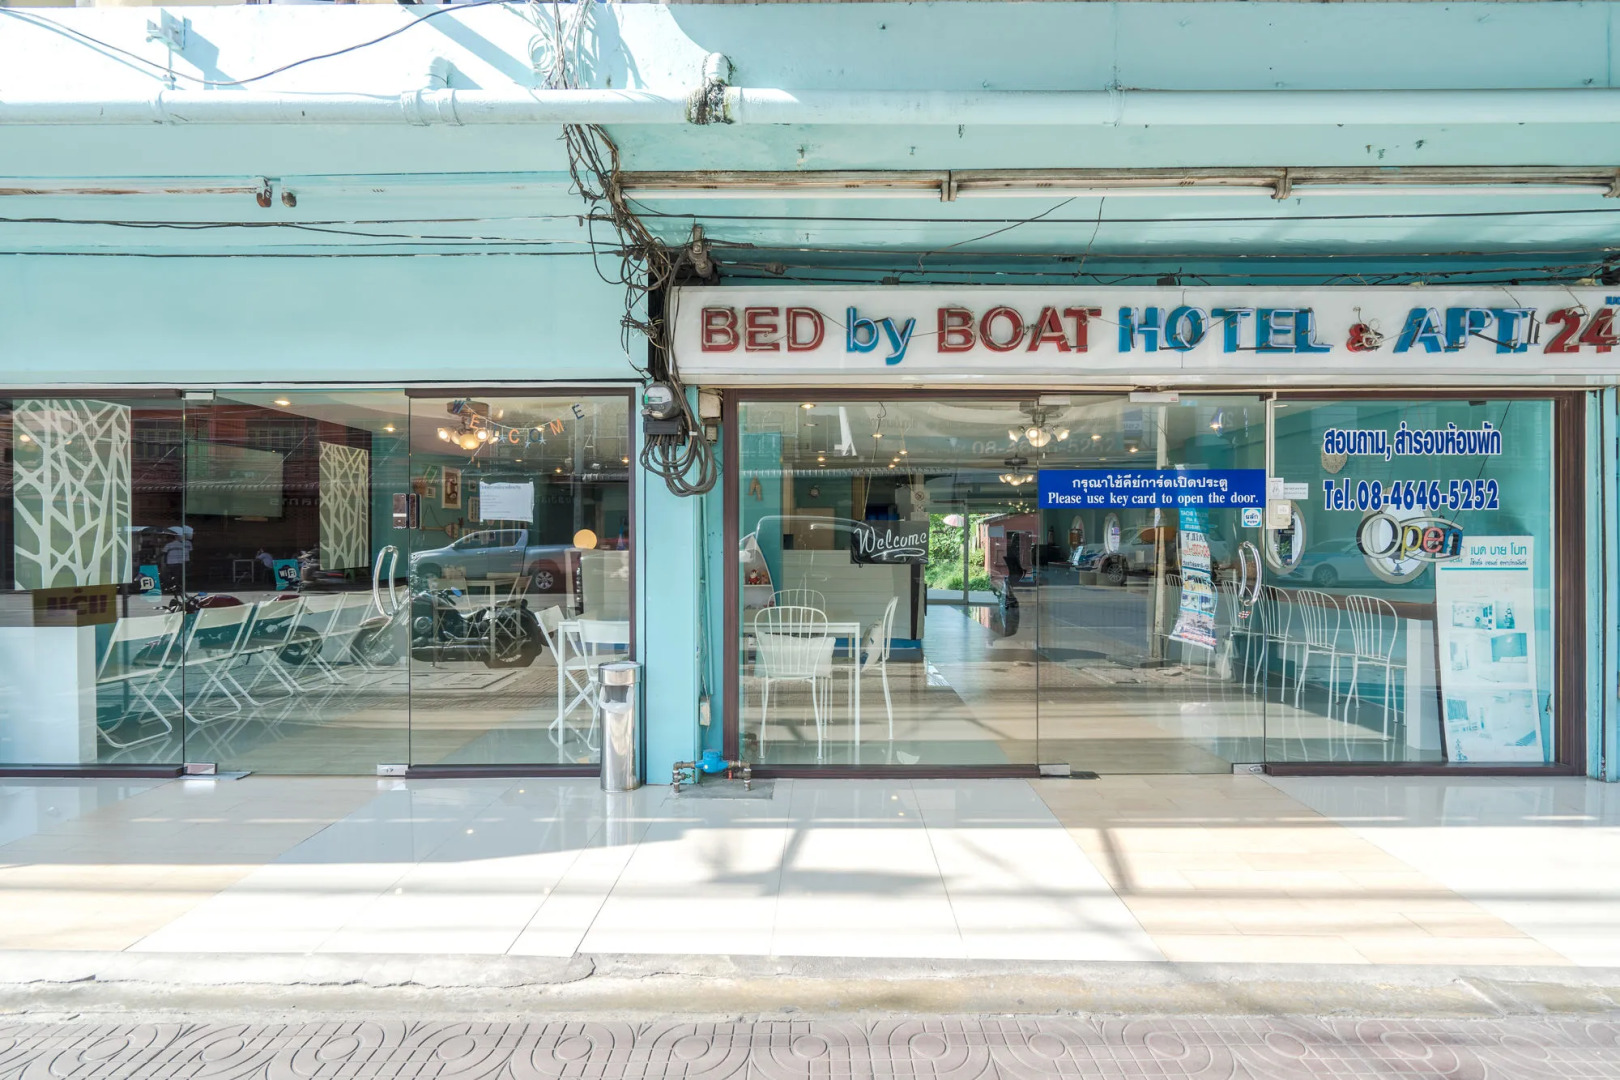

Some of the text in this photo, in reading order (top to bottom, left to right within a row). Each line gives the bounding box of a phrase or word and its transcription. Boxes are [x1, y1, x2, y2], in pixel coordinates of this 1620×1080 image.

[701, 306, 825, 353] BED
[846, 306, 916, 366] by
[937, 306, 1102, 353] BOAT
[1119, 306, 1333, 353] HOTEL
[1323, 421, 1502, 461] สอบถาม, สำรองห้องพัก
[1048, 491, 1259, 507] Please use key card to open the door.
[1072, 475, 1228, 492] กรุณาใช้คีย์การ์ดเปิดประตู
[854, 526, 927, 554] Welcome
[1357, 513, 1463, 560] Open
